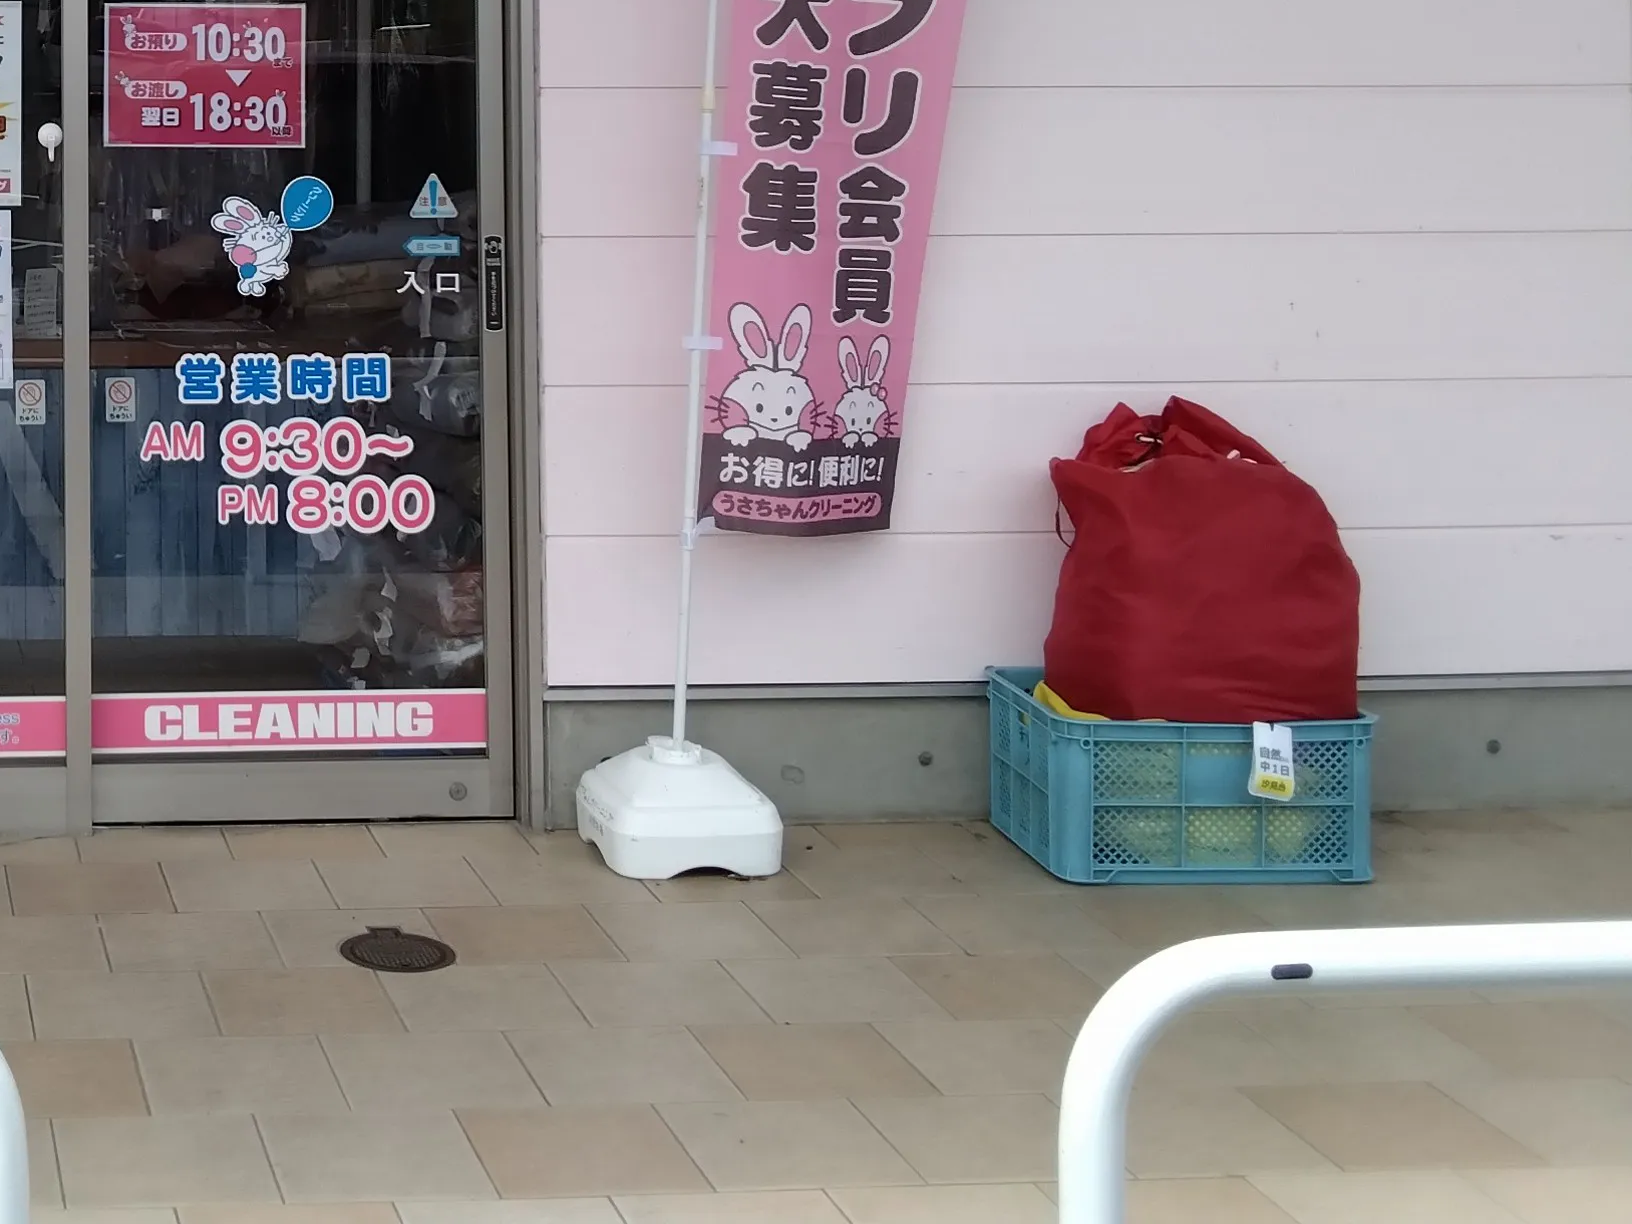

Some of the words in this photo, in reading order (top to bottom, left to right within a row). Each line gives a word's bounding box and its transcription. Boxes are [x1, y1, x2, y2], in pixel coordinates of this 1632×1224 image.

[131, 33, 179, 51] お預り
[191, 23, 286, 63] 10:30
[131, 81, 181, 99] お渡し
[141, 106, 180, 128] 翌日
[190, 92, 287, 132] 18:30
[397, 270, 460, 295] 入口
[176, 353, 391, 404] 営業時間
[140, 421, 204, 461] AM
[218, 485, 278, 525] PM
[286, 474, 435, 534] 8:00
[720, 493, 877, 520] うさちゃんクリーニング
[144, 701, 434, 741] CLEANING
